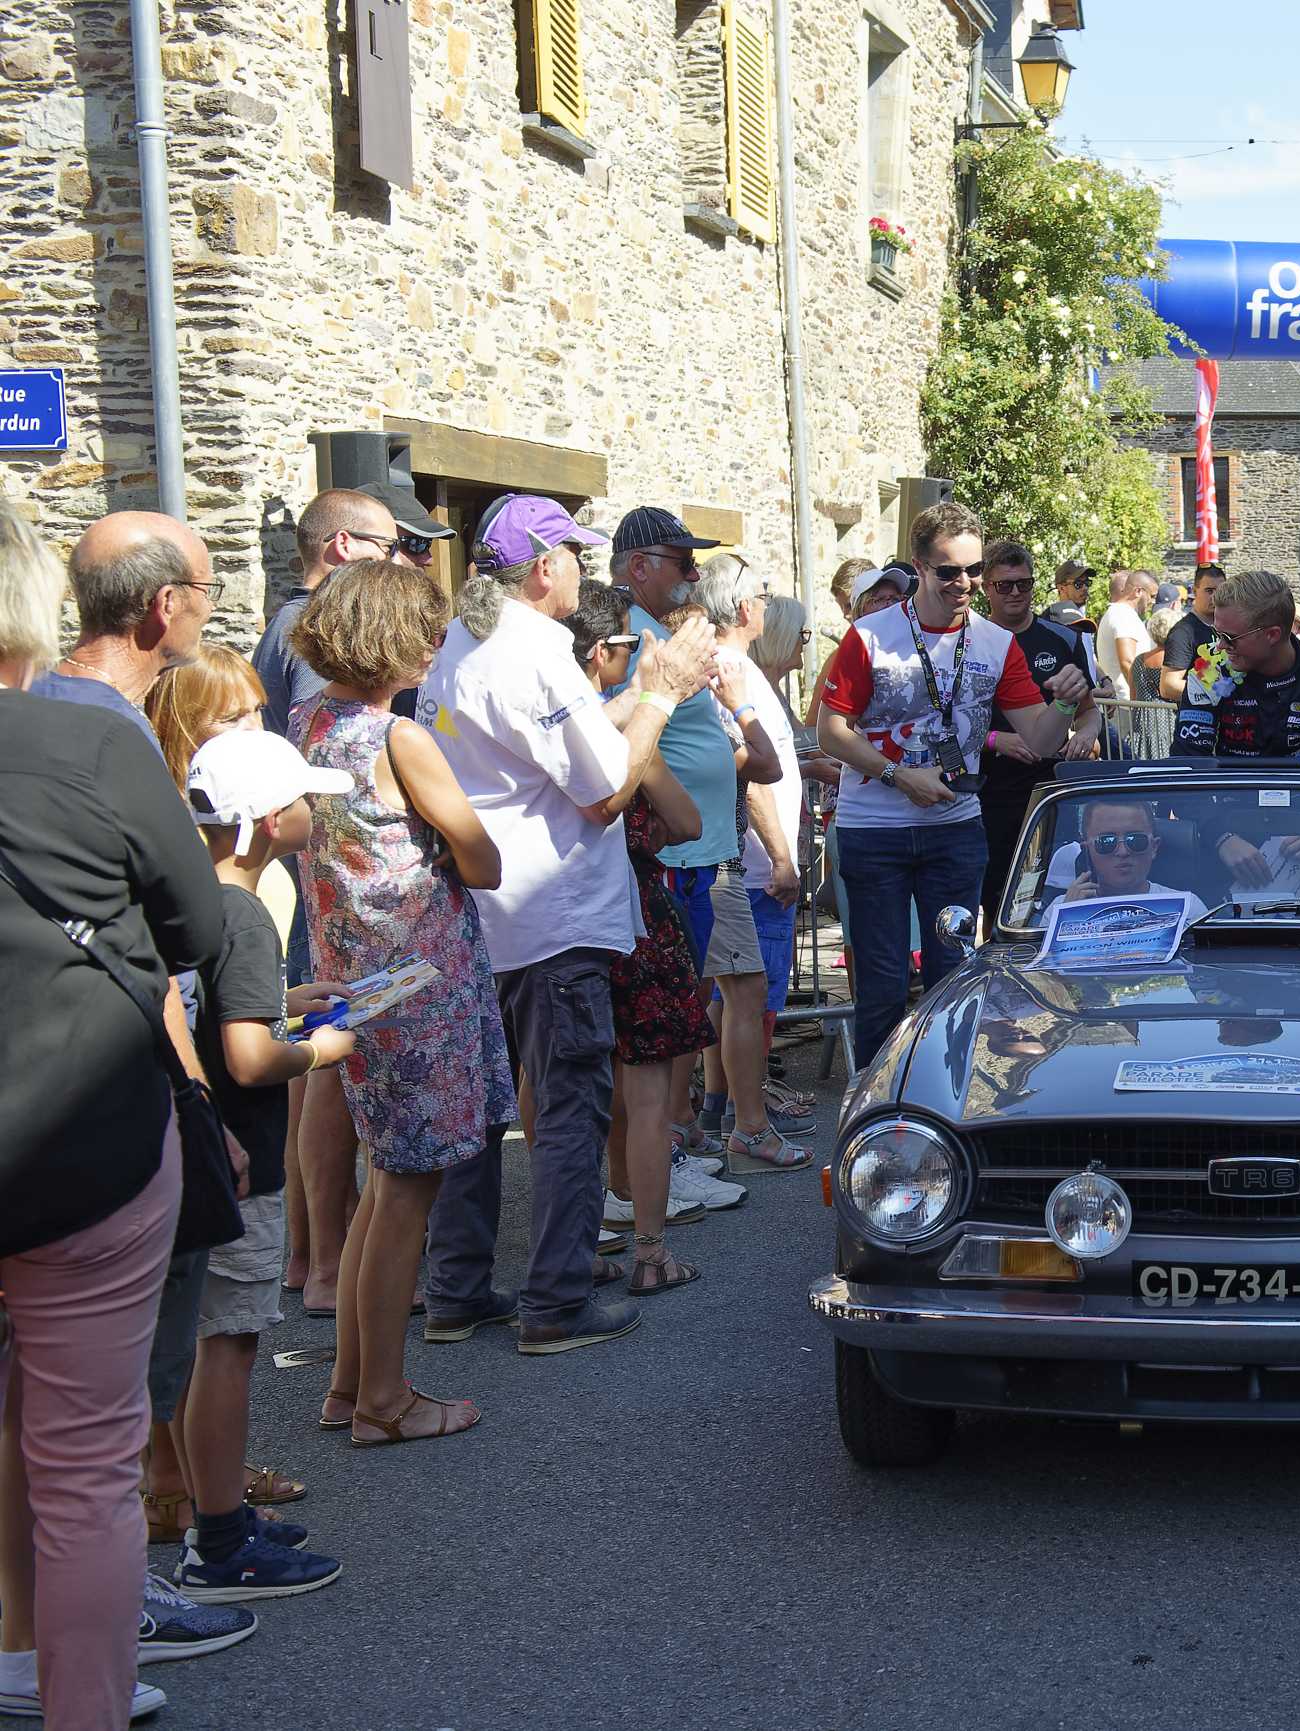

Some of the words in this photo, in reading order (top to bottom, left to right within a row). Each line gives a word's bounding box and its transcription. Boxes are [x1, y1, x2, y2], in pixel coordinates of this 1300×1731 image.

[0, 413, 40, 431] rdun
[1126, 1070, 1205, 1079] PARADE
[1136, 1076, 1205, 1084] PILOTES
[1215, 1168, 1295, 1188] TR6
